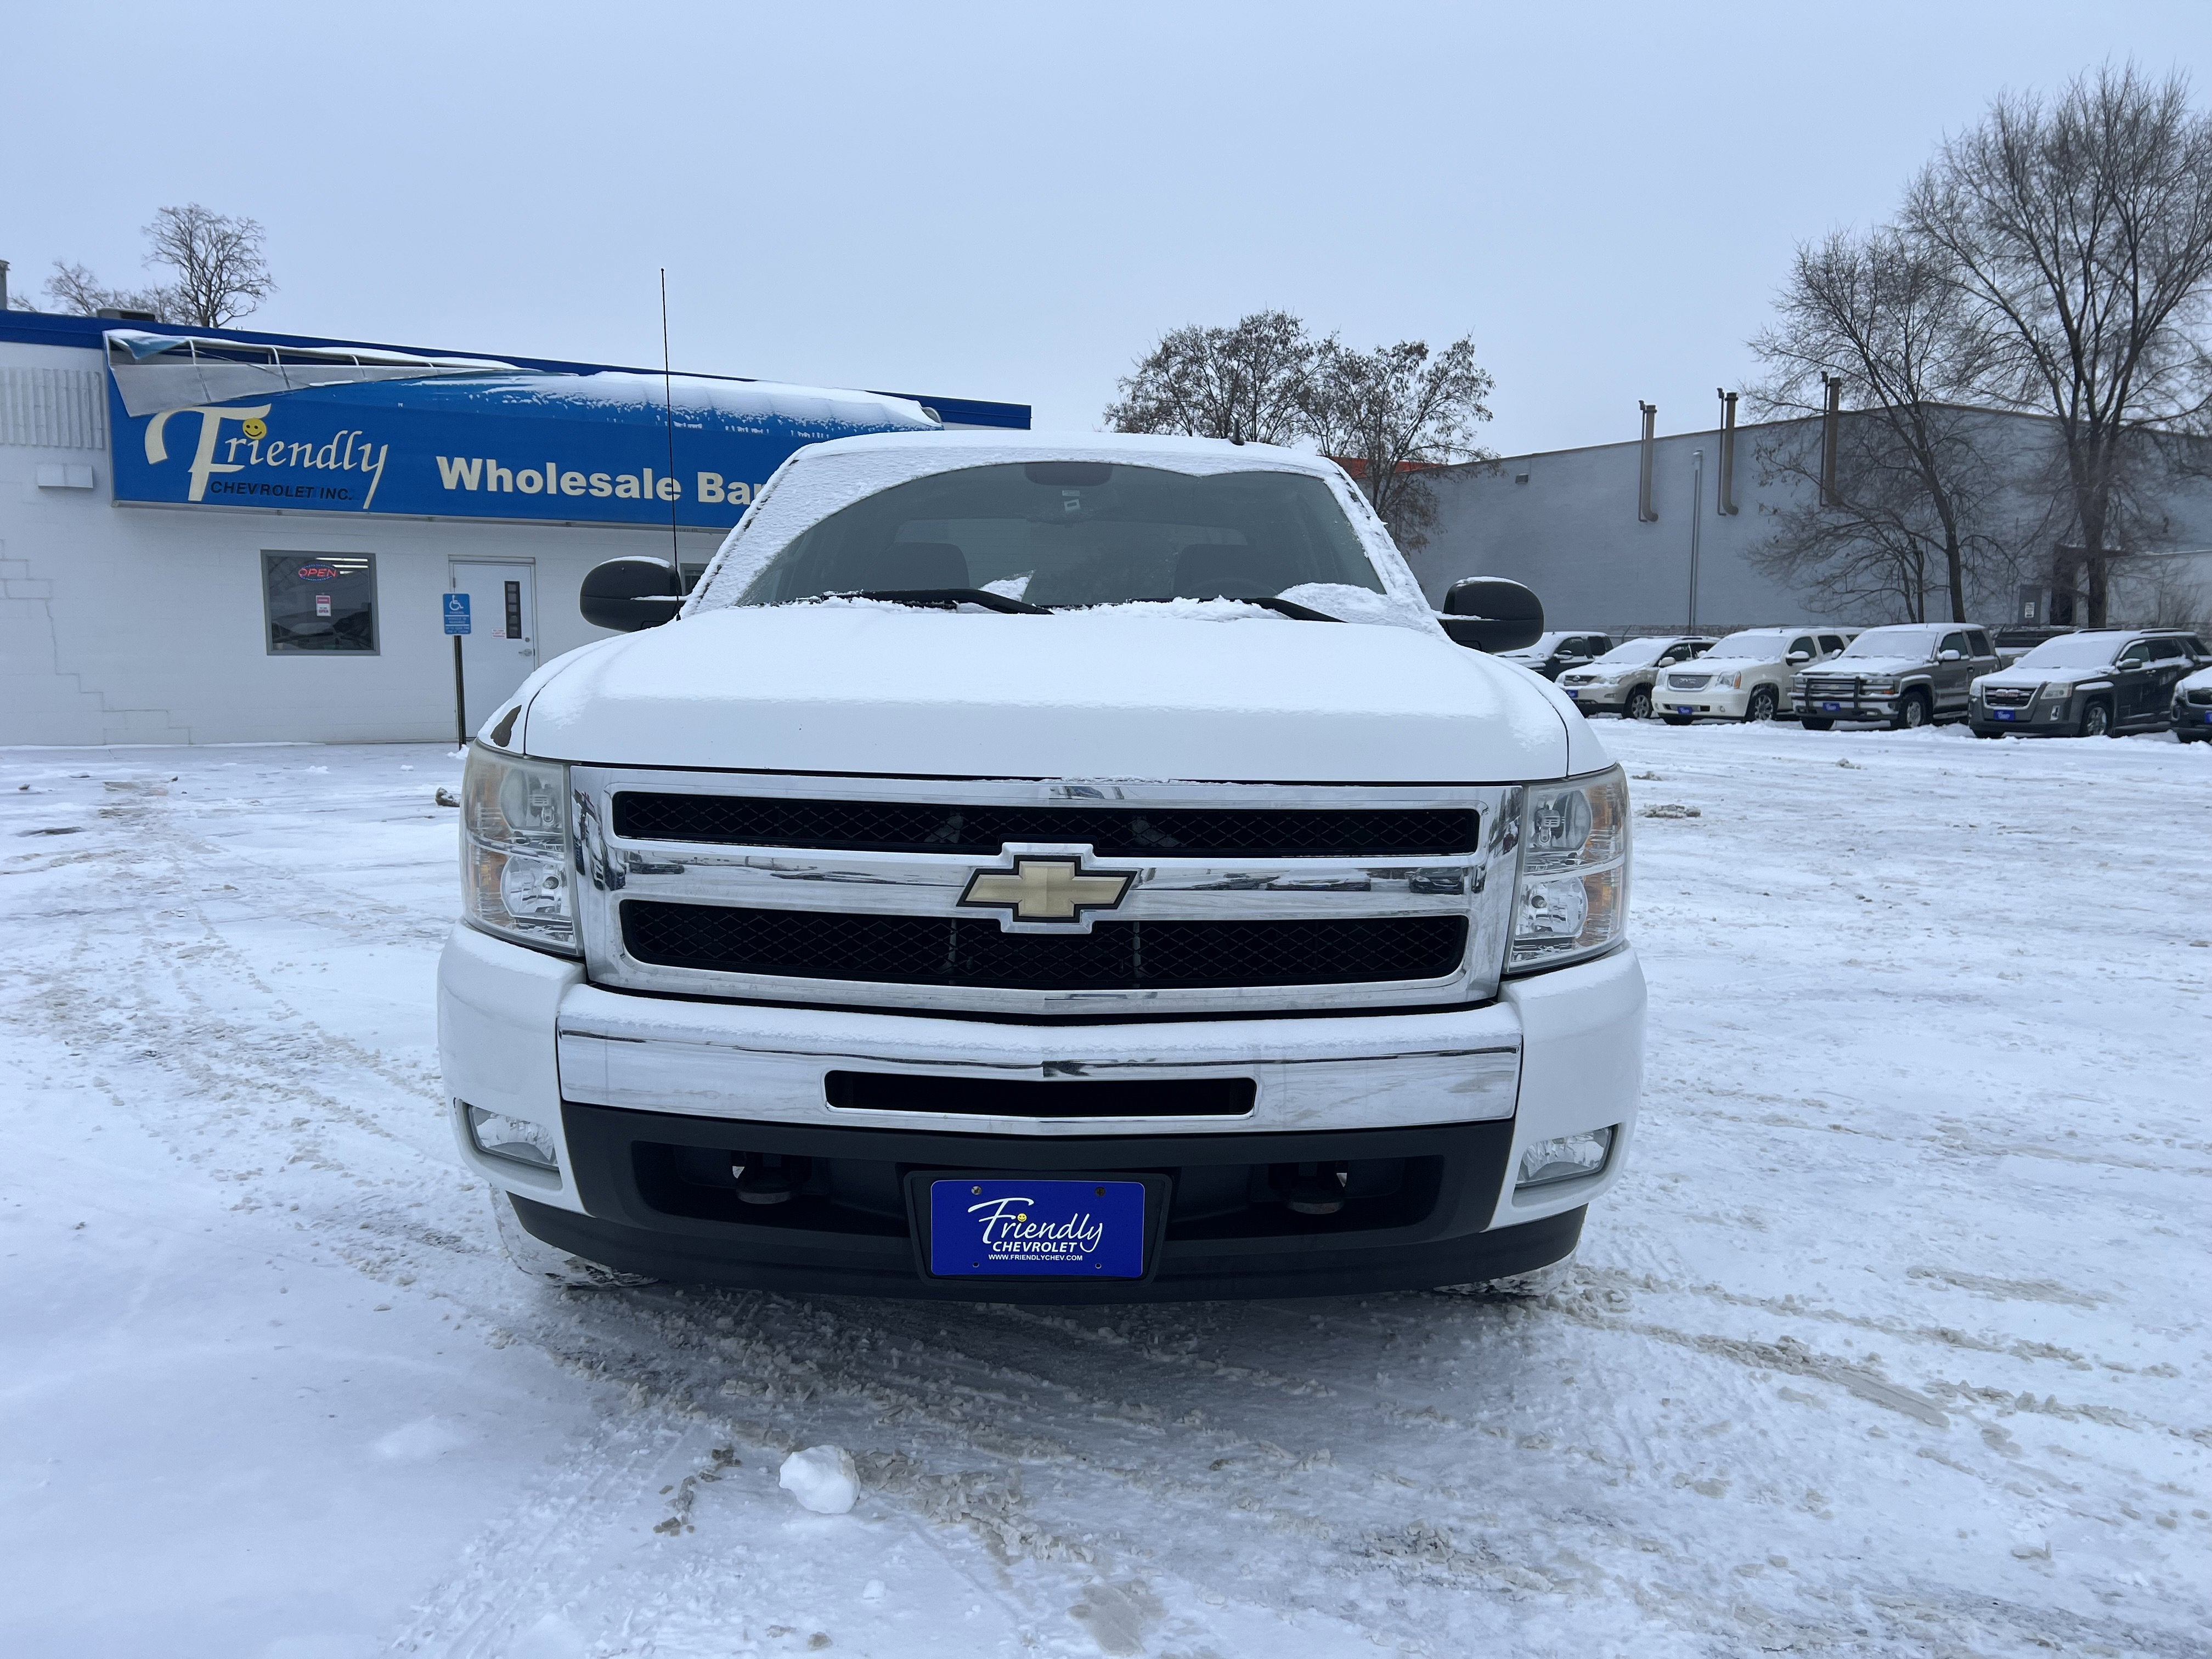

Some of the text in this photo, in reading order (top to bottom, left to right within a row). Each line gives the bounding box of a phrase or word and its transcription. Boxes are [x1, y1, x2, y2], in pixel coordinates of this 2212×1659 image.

[144, 403, 388, 510] Friendly
[210, 481, 353, 501] CHEVROLET INC.
[436, 455, 681, 501] Wholesale
[298, 567, 337, 578] OPEN
[968, 1197, 1103, 1252] Friendly
[992, 1241, 1077, 1253] CHEVROLET
